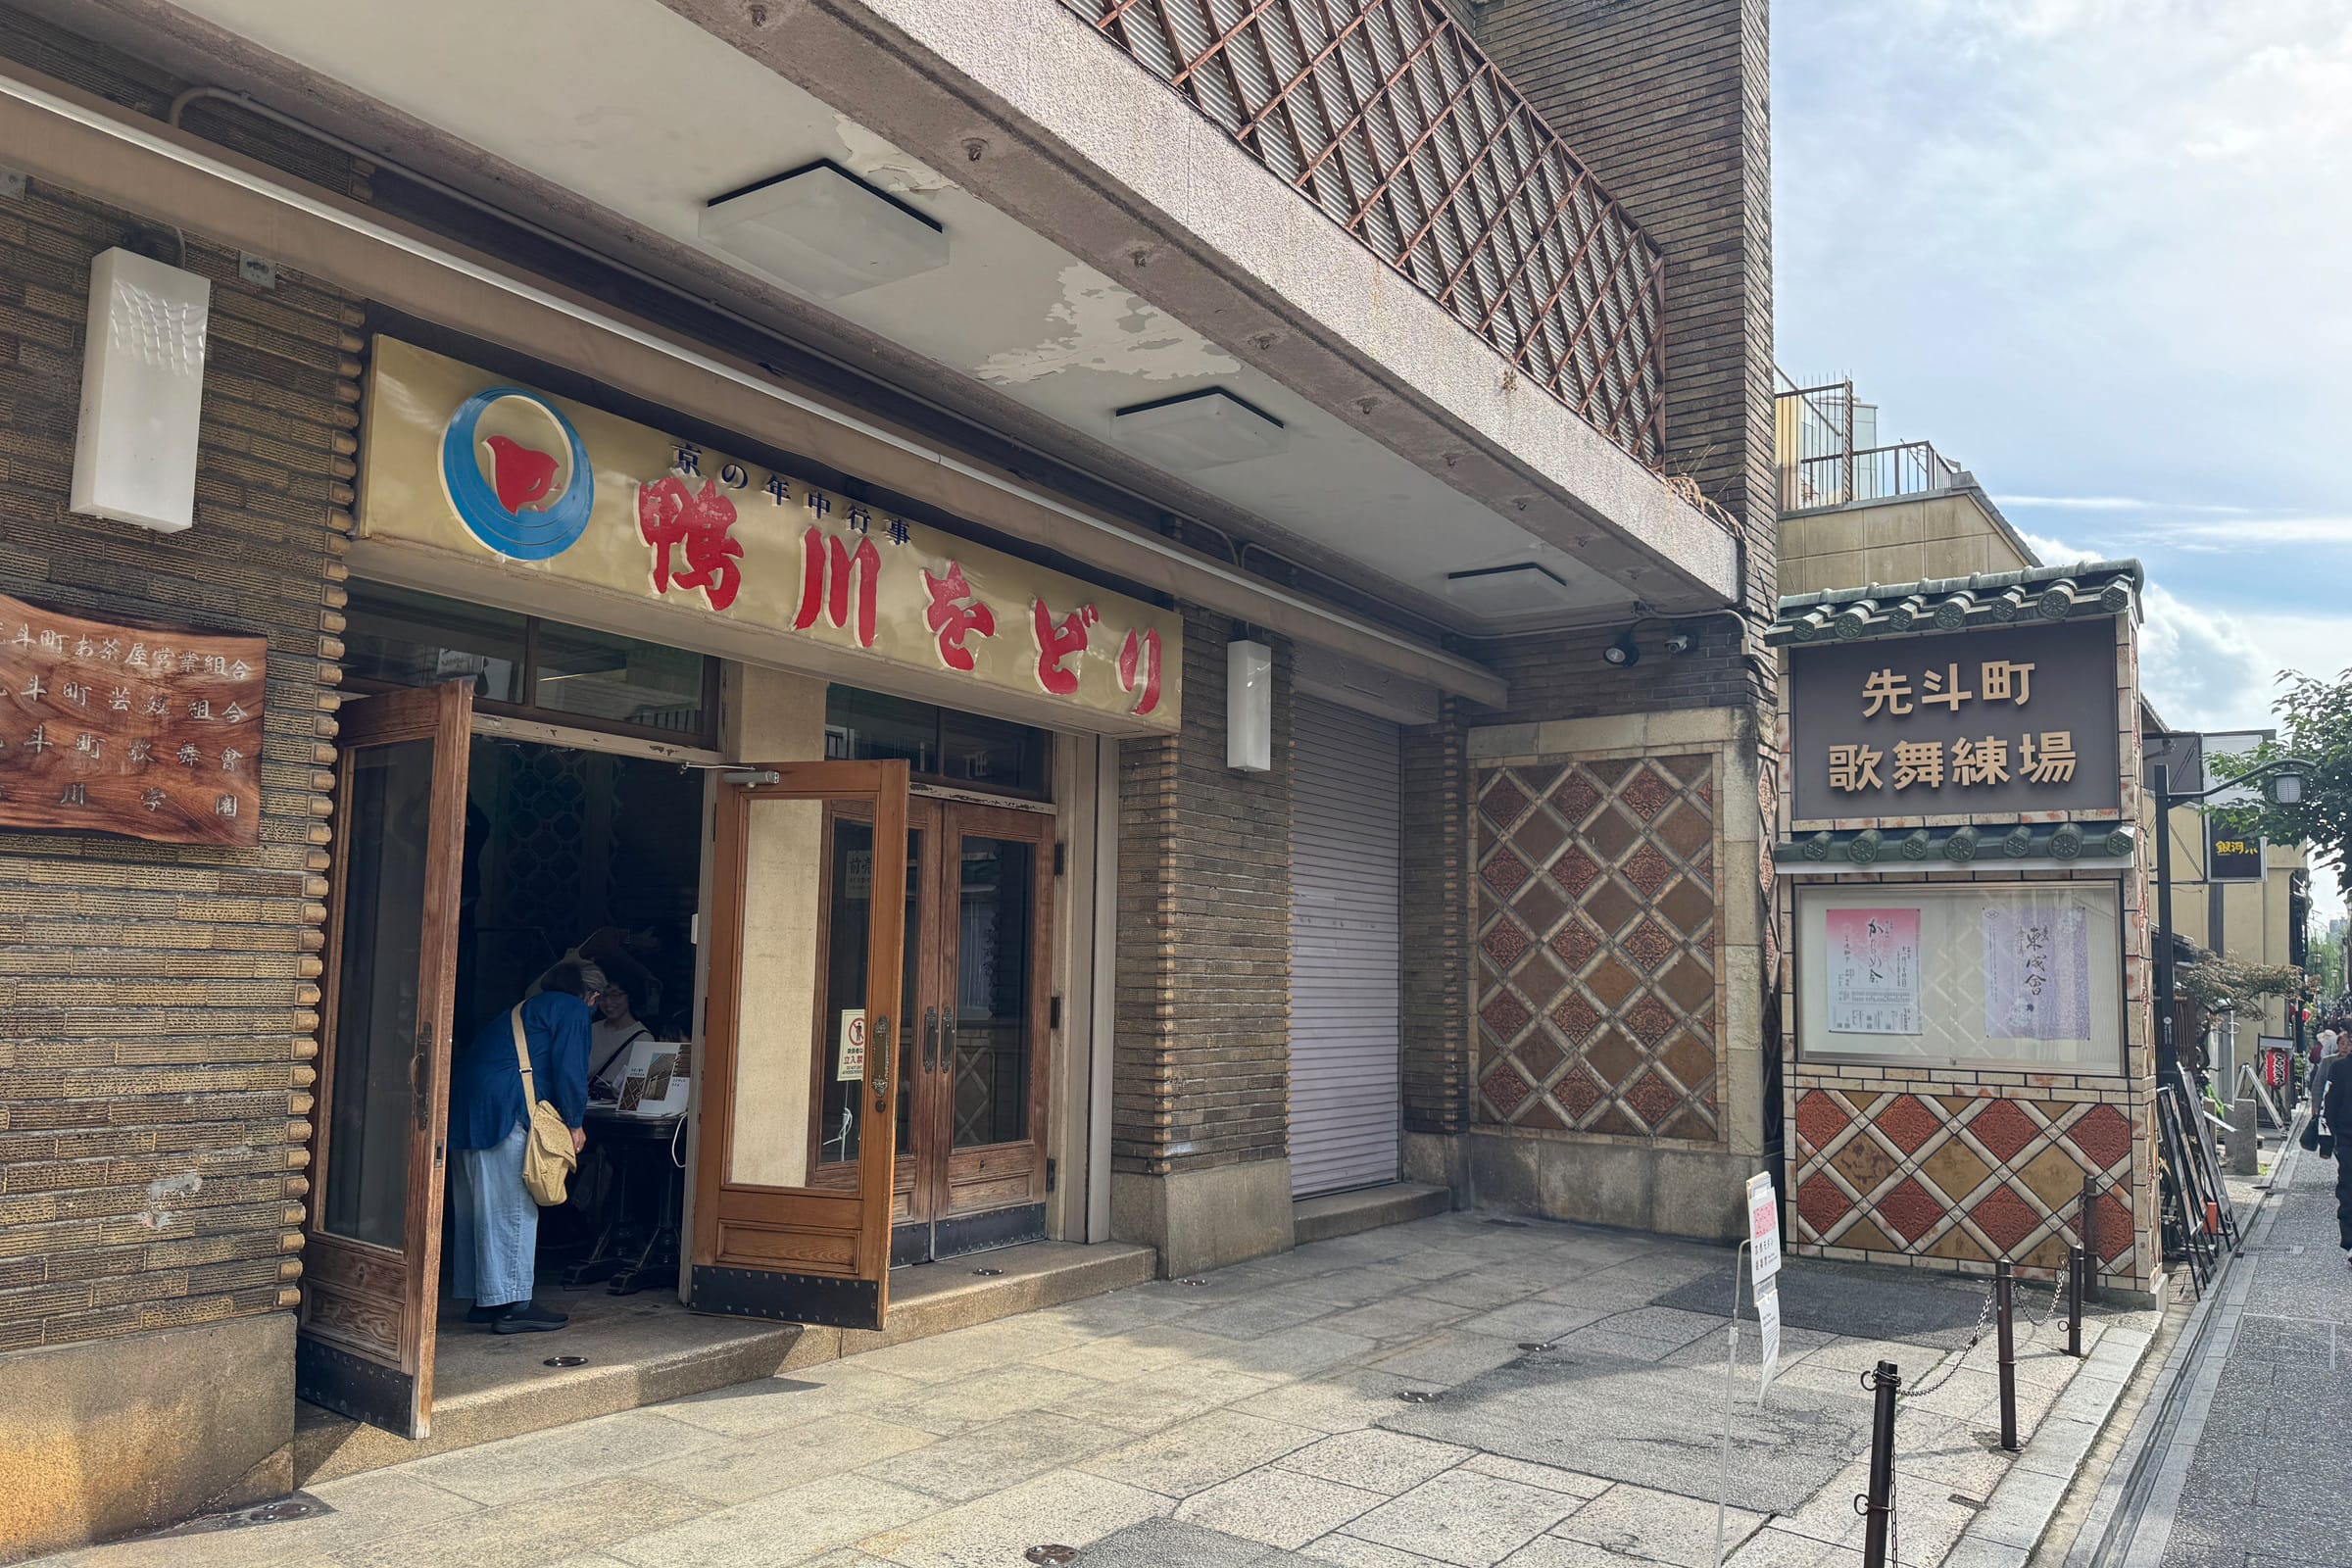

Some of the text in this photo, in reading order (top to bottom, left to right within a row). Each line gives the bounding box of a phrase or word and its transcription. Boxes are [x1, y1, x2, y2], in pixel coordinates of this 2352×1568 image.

[672, 444, 912, 547] 京の年中行事
[635, 475, 1164, 717] 鴨川をどり
[0, 674, 249, 723] 斗町芸妓組合
[1861, 659, 2036, 718] 先斗町
[0, 723, 243, 772] 斗町歌舞會
[1828, 730, 2078, 793] 歌舞練場
[0, 782, 238, 819] 川学園
[2215, 840, 2259, 856] 銀河
[843, 1054, 863, 1065] 立入禁
